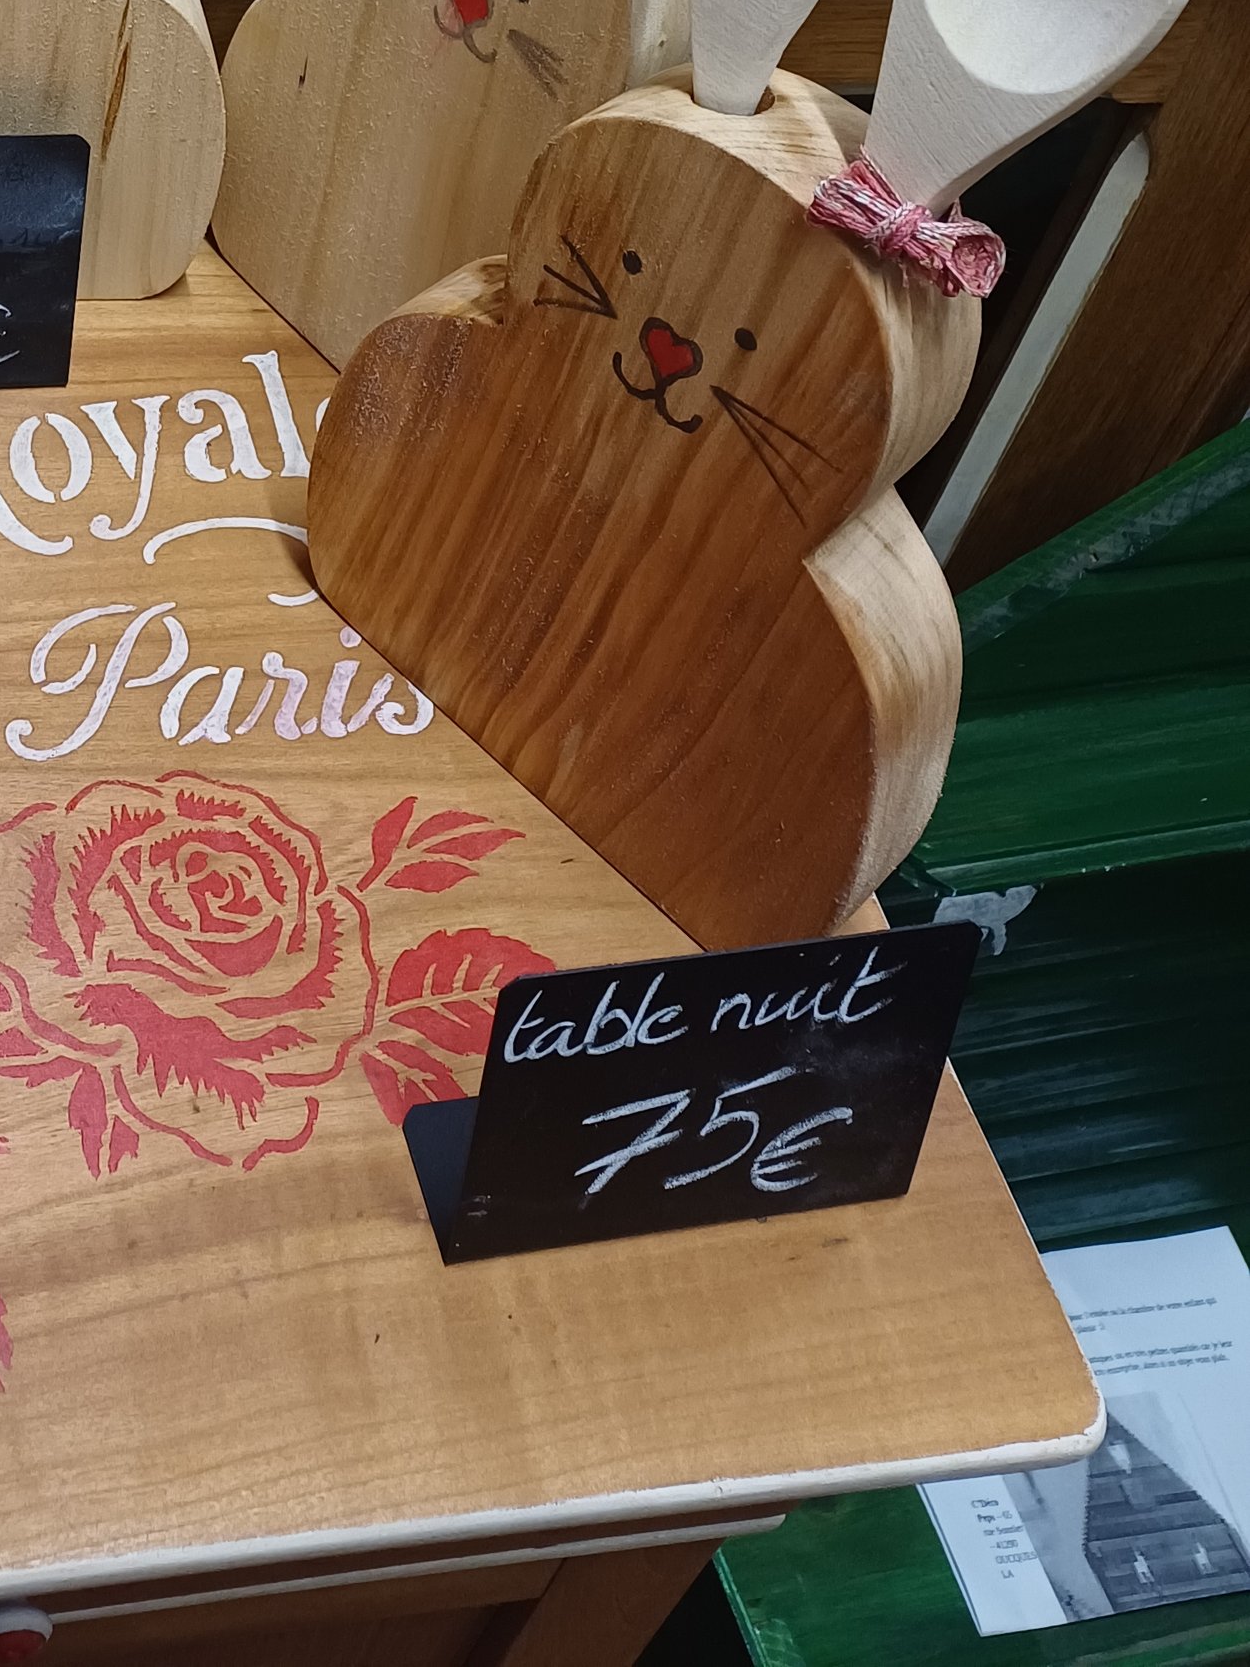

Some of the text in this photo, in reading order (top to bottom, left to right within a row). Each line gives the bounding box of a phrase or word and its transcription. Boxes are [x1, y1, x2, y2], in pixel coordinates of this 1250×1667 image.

[6, 601, 436, 761] Paris
[504, 945, 909, 1063] table nuit
[574, 1065, 853, 1197] 75€
